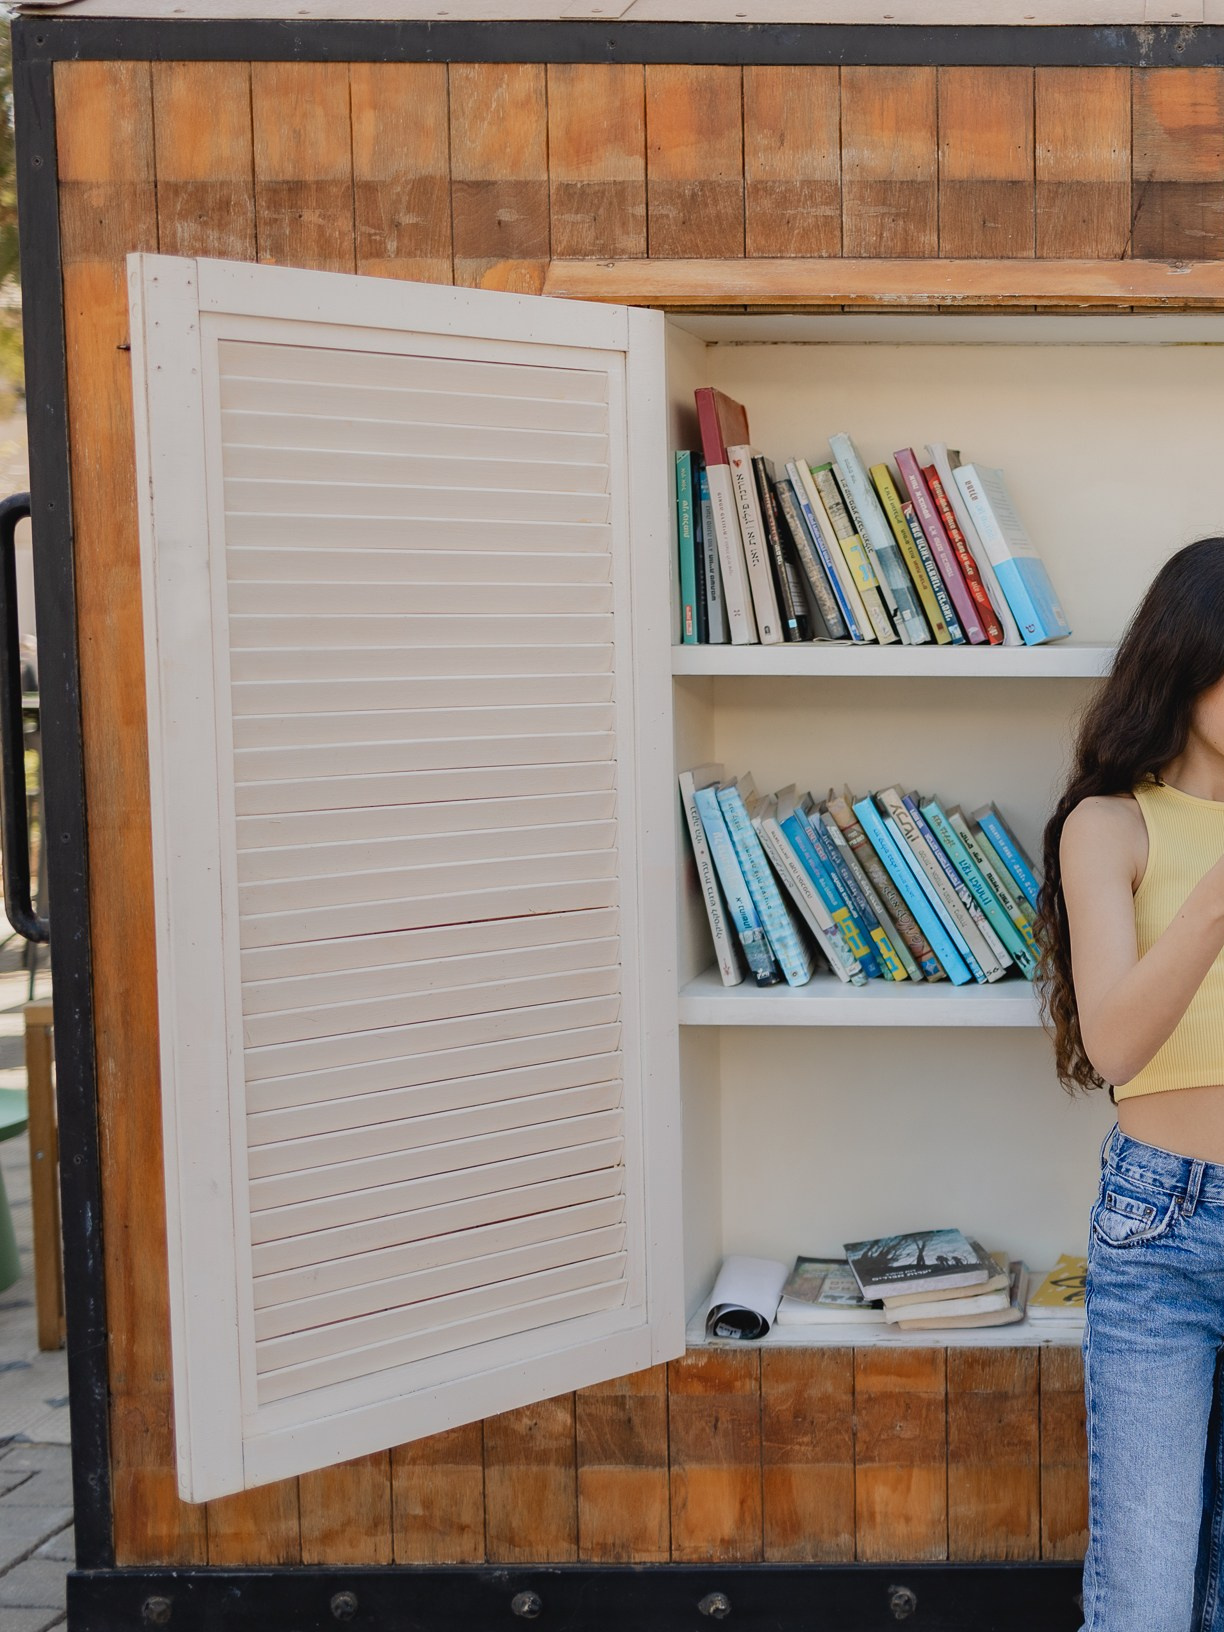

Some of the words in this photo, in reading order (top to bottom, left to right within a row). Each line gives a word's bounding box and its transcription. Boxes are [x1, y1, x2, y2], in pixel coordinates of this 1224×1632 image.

[735, 473, 747, 501] אורנה
[740, 502, 754, 524] פילין
[847, 499, 858, 515] מסע
[852, 515, 865, 532] לעבר
[944, 511, 957, 529] הקטנה
[746, 531, 756, 545] את
[909, 521, 922, 538] עמק
[927, 524, 937, 535] לא
[915, 538, 930, 560] הלואר
[956, 541, 965, 553] פעם
[749, 548, 760, 566] ואני
[959, 552, 968, 561] לא
[963, 560, 974, 575] חייכה
[917, 573, 927, 589] שברים
[935, 590, 954, 621] ובריטאני
[689, 805, 700, 826] רבקה
[887, 799, 921, 843] עכשיו
[693, 829, 702, 843] הלוי
[917, 849, 931, 866] ספרות
[701, 860, 711, 883] עברית
[706, 886, 716, 906] בדגש
[968, 874, 992, 906] האחרון
[710, 908, 723, 939] לקסיקלי
